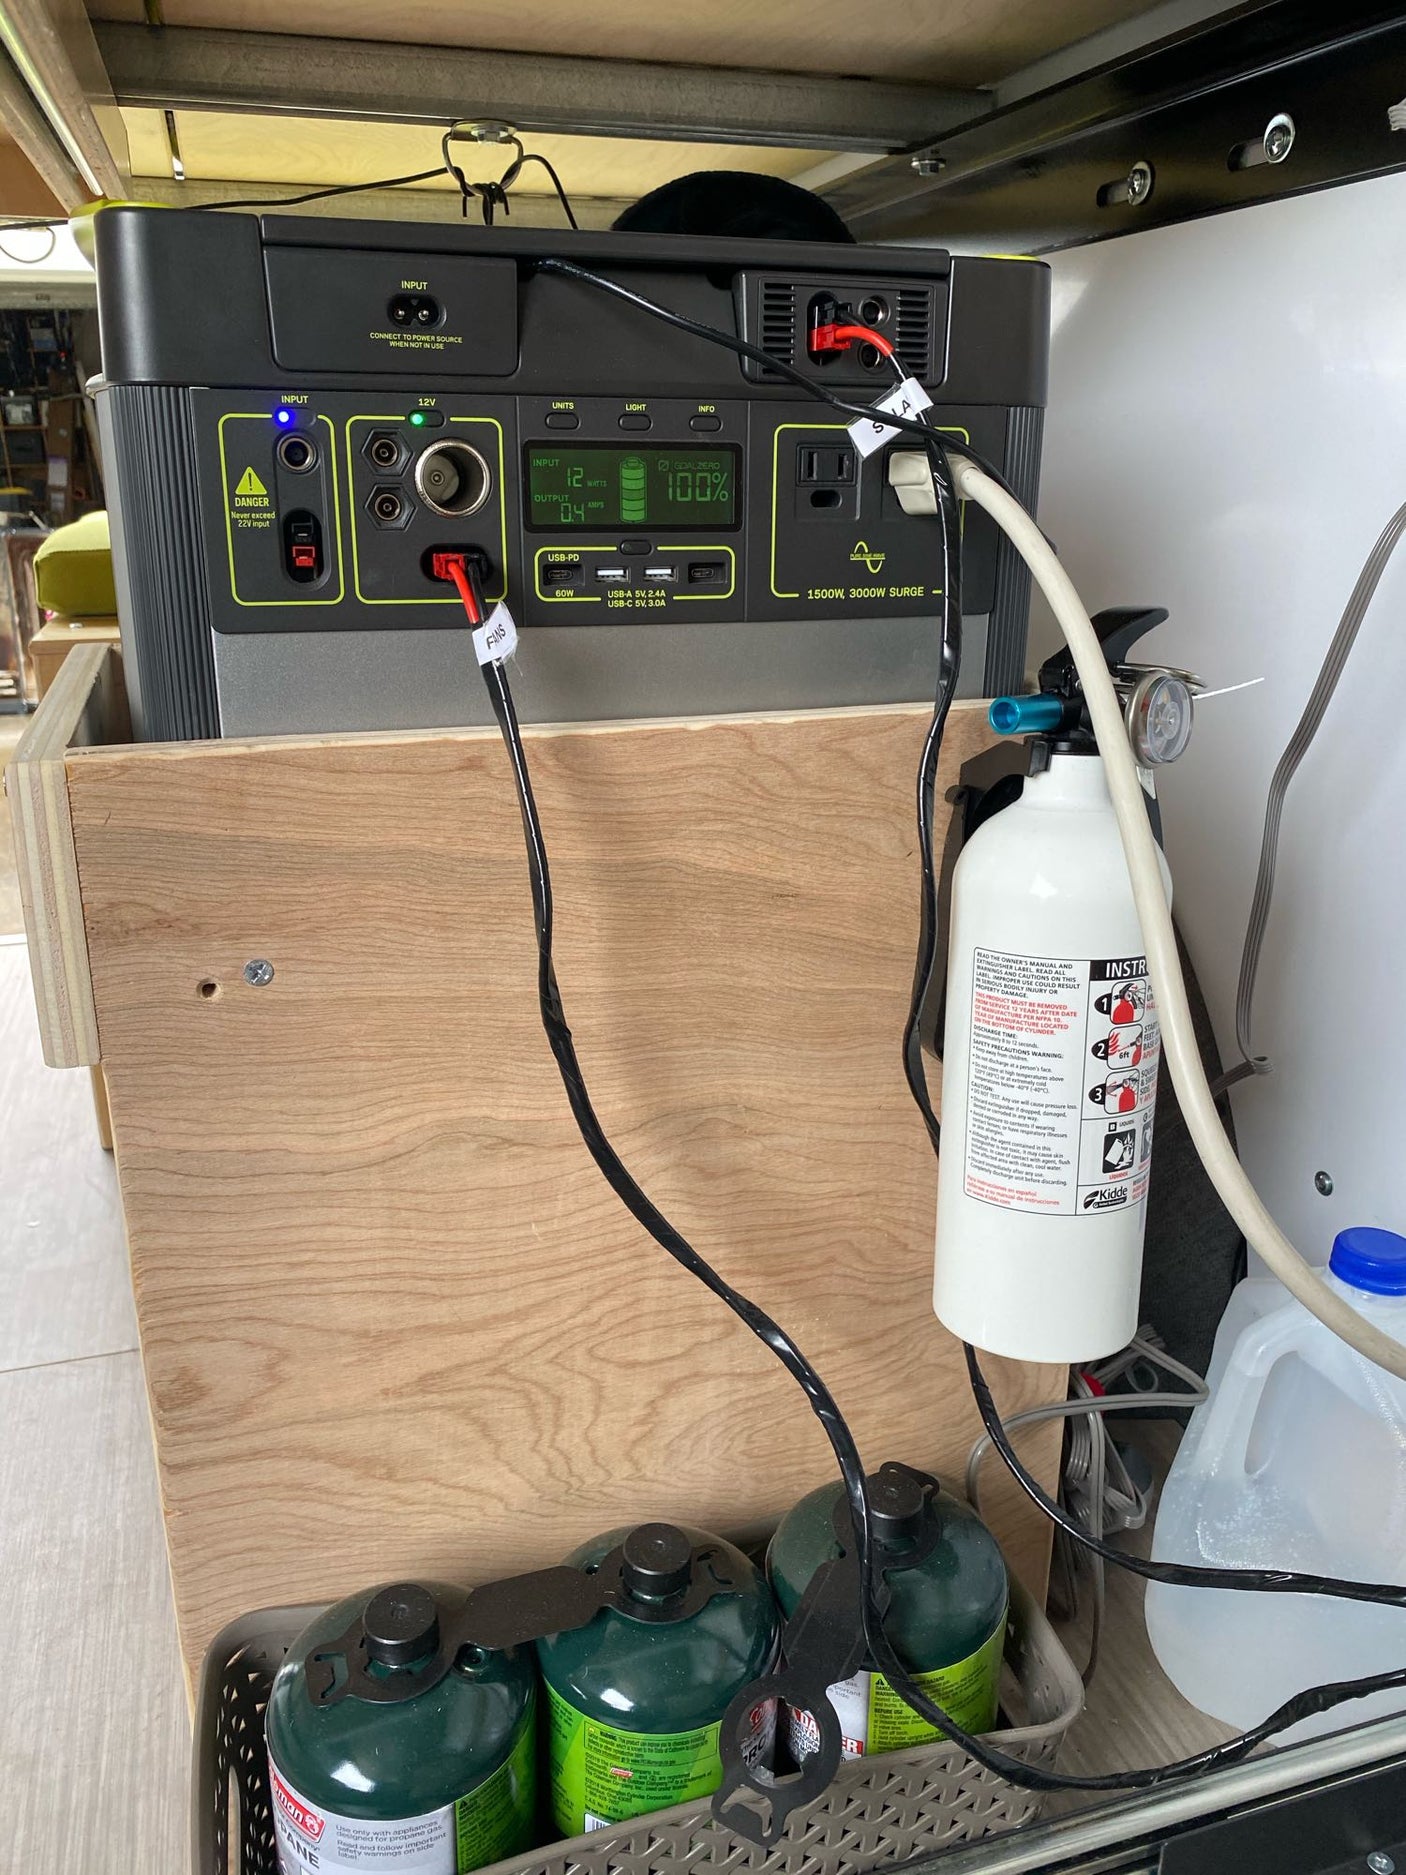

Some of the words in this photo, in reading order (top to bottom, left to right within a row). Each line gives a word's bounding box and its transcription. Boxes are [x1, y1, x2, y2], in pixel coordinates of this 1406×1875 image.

[401, 280, 428, 290] INPUT
[369, 332, 401, 340] CONNECT
[412, 334, 435, 342] POWER
[281, 395, 308, 404] INPUT
[418, 398, 436, 406] 12V
[552, 402, 574, 410] UNITS
[698, 405, 715, 413] INFO
[871, 398, 912, 434] SLA
[533, 459, 560, 467] INPUT
[567, 467, 584, 487] 12
[668, 472, 728, 501] 100%
[235, 497, 269, 507] DANGER
[534, 494, 569, 502] OUTPUT
[252, 511, 276, 519] exceed
[561, 503, 585, 522] 0.4
[253, 520, 270, 528] input
[547, 554, 580, 562] USB-PD
[607, 590, 632, 598] USB-A
[635, 590, 647, 598] 5V,
[648, 590, 666, 598] 2.4A
[807, 588, 845, 600] 1500W,
[849, 587, 886, 598] 3000W
[889, 587, 925, 597] SURGE
[635, 600, 647, 608] 5V,
[486, 623, 506, 650] FANS
[1029, 961, 1057, 969] MANUAL
[1018, 972, 1049, 981] CAUTIONS
[1097, 1042, 1105, 1057] 2
[1119, 1051, 1129, 1059] 6ft
[1094, 1087, 1102, 1102] 3
[1100, 1186, 1128, 1200] Kidde
[336, 1824, 351, 1832] Use
[352, 1829, 370, 1837] only
[392, 1821, 438, 1836] appliances
[405, 1832, 447, 1848] important
